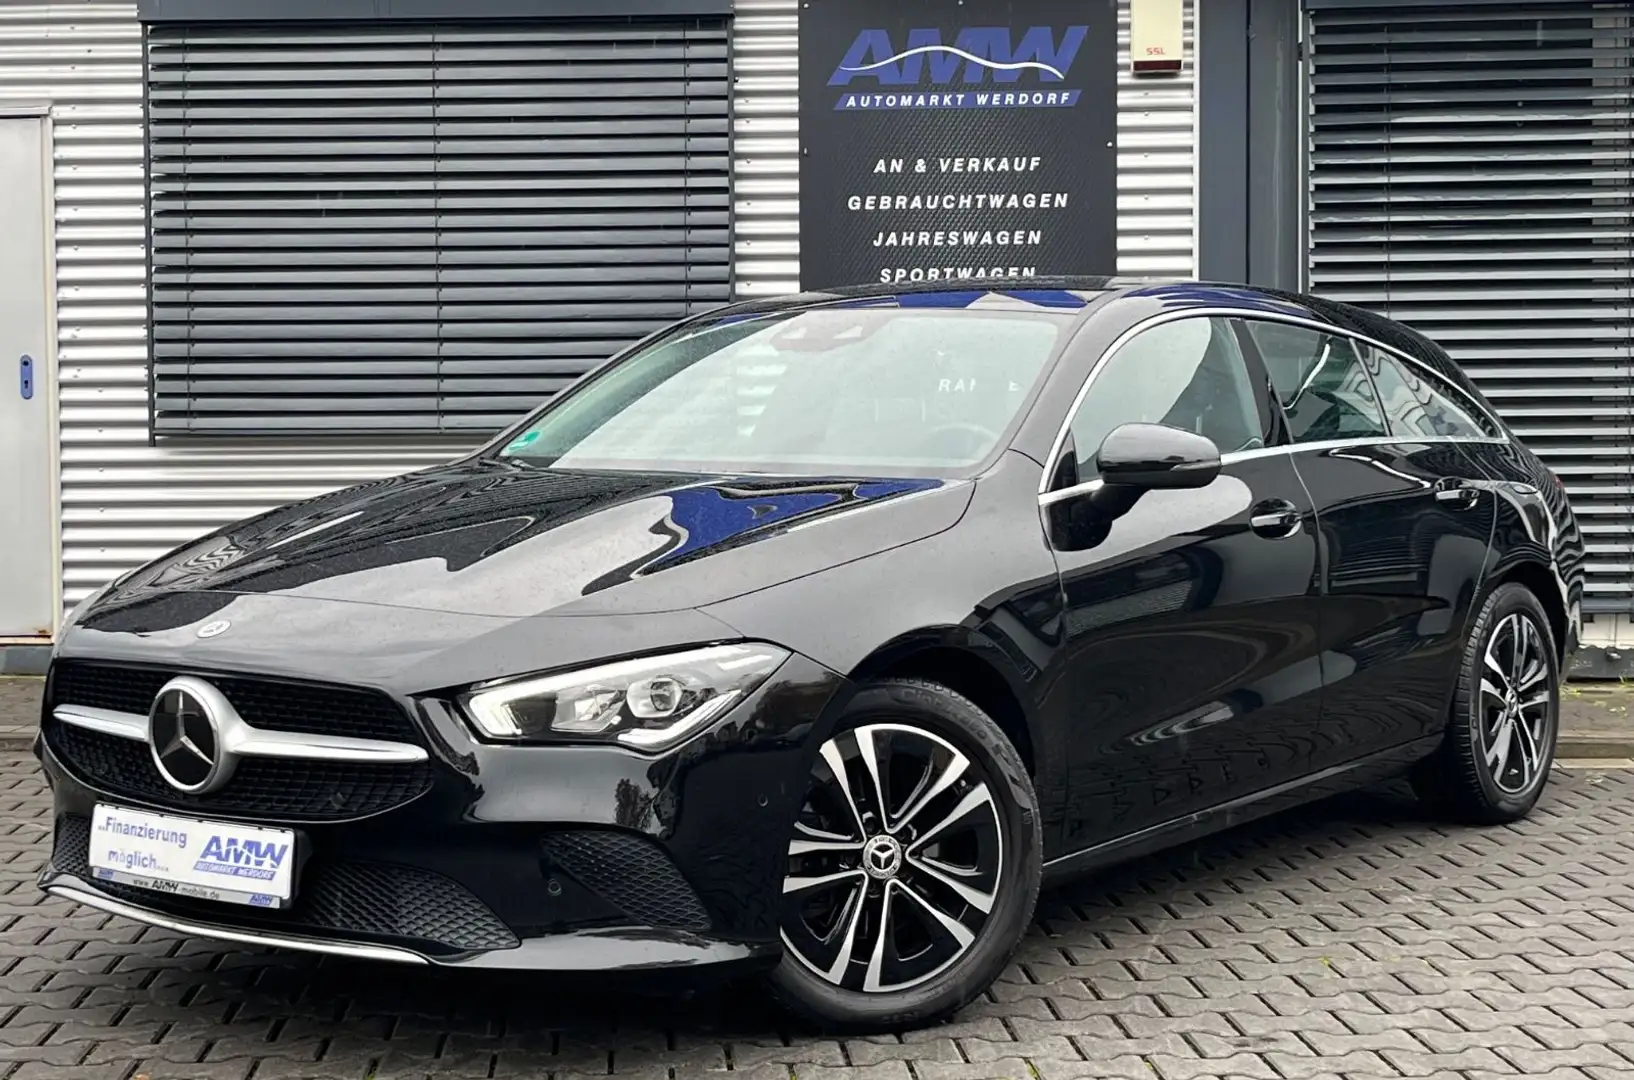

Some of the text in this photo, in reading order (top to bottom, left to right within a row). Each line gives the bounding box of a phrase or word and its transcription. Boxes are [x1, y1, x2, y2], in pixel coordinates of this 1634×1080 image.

[827, 25, 1090, 86] AMW
[1146, 47, 1166, 56] SSL
[846, 92, 1070, 108] AUTOMARKT WERDORF
[873, 157, 1042, 173] AN & VERKAUF
[847, 193, 1069, 211] GEBRAUCHTWAGEN
[873, 230, 1042, 248] JAHRESWAGEN
[200, 835, 289, 869] AMW
